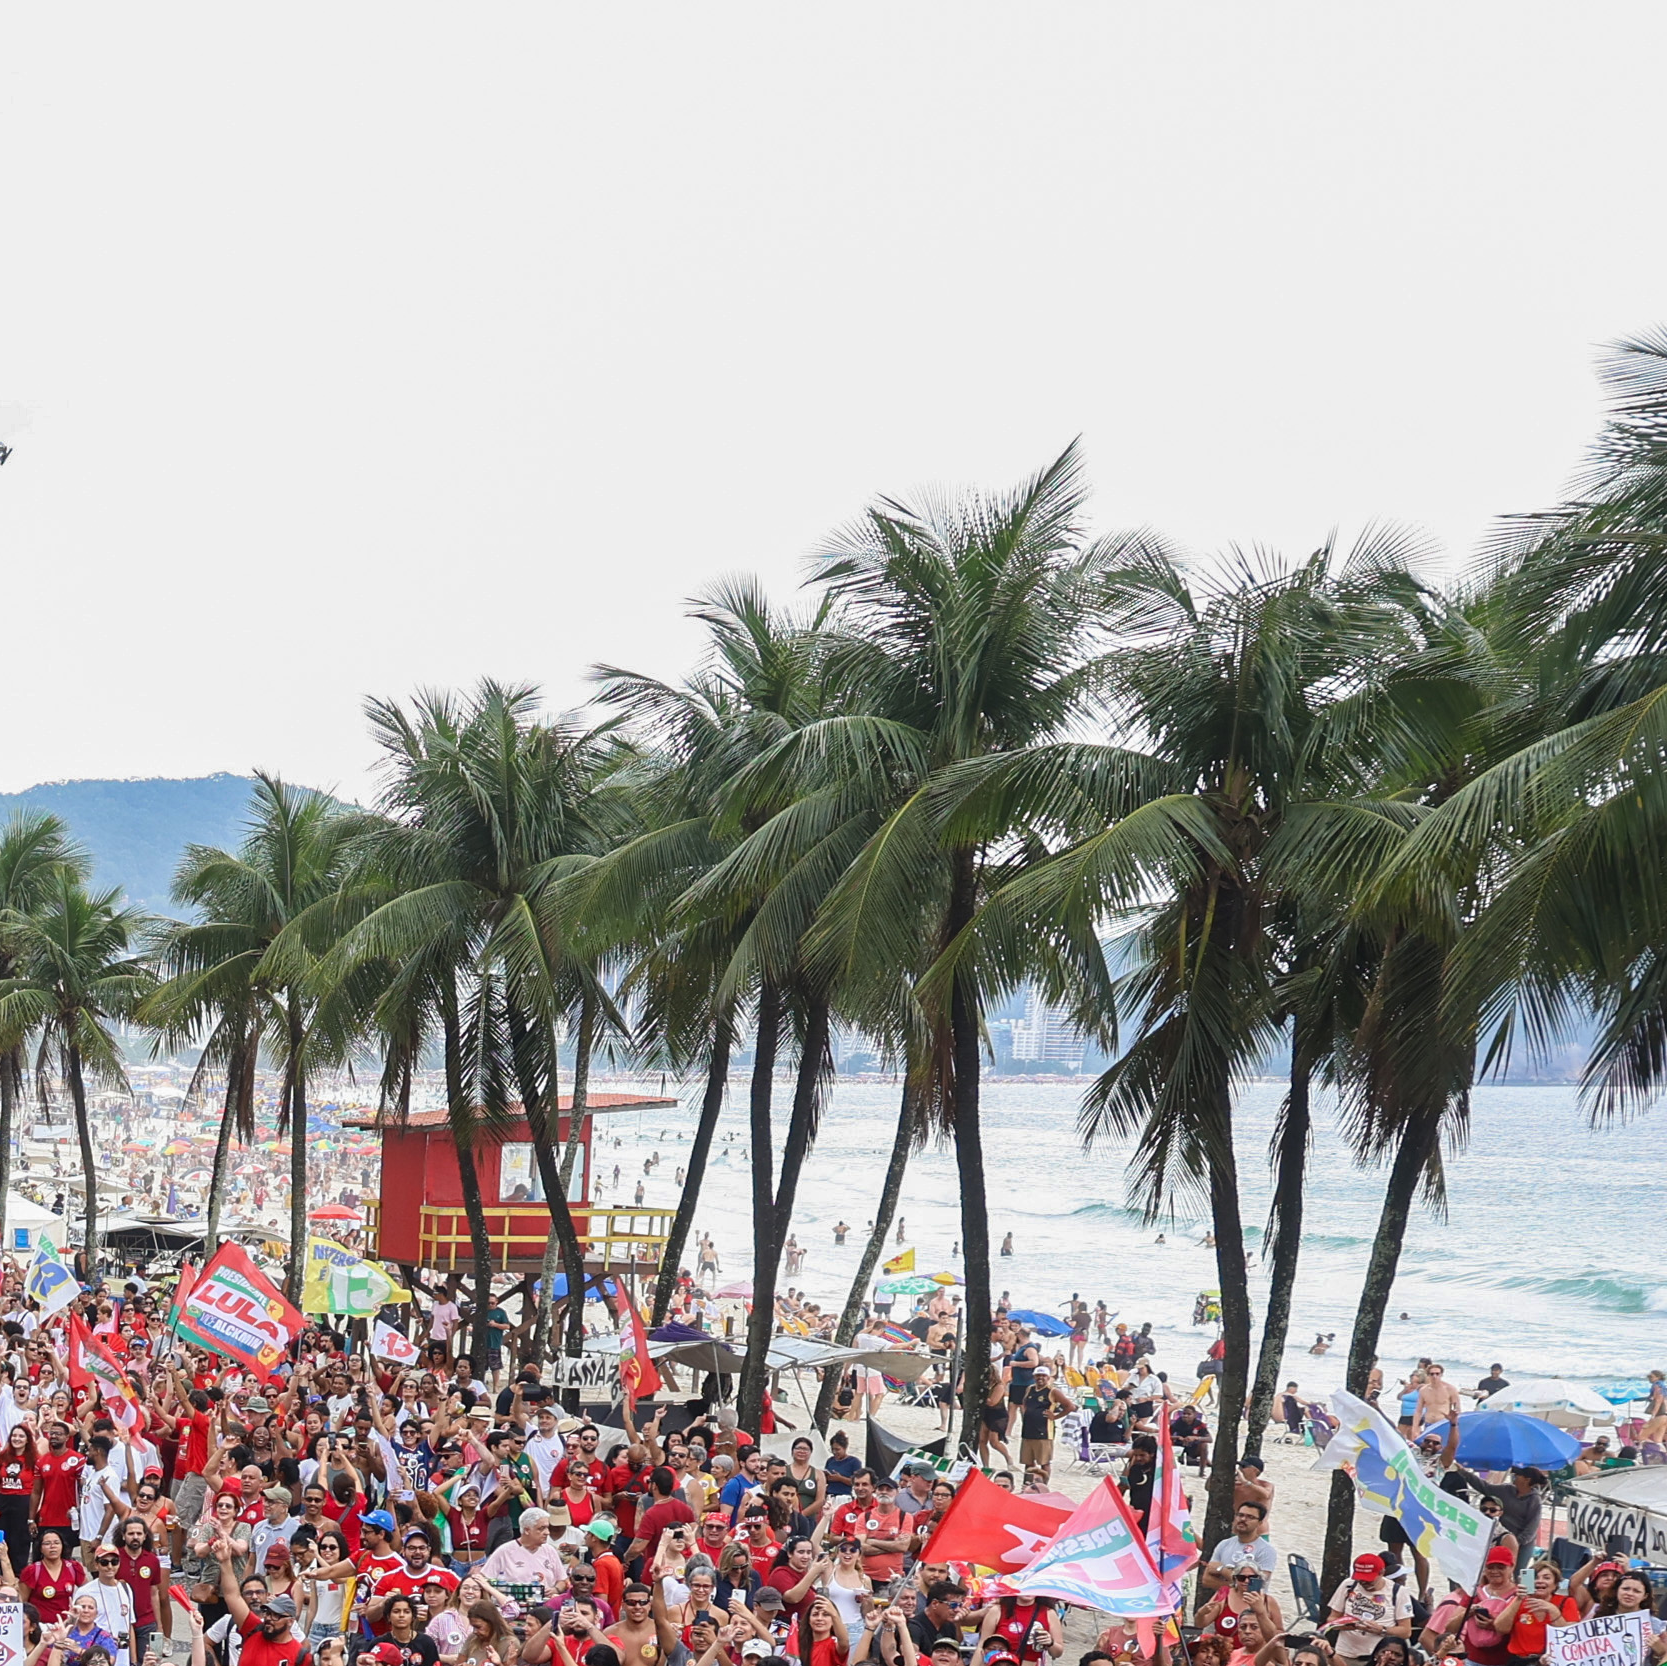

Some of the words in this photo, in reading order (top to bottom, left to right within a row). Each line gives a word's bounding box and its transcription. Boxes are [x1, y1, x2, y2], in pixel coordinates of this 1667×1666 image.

[215, 1264, 269, 1307] PRESIDENTE
[195, 1283, 281, 1341] LULA
[385, 1333, 414, 1355] 13
[1585, 1615, 1627, 1637] UERJ
[1562, 1638, 1618, 1662] CONTRA
